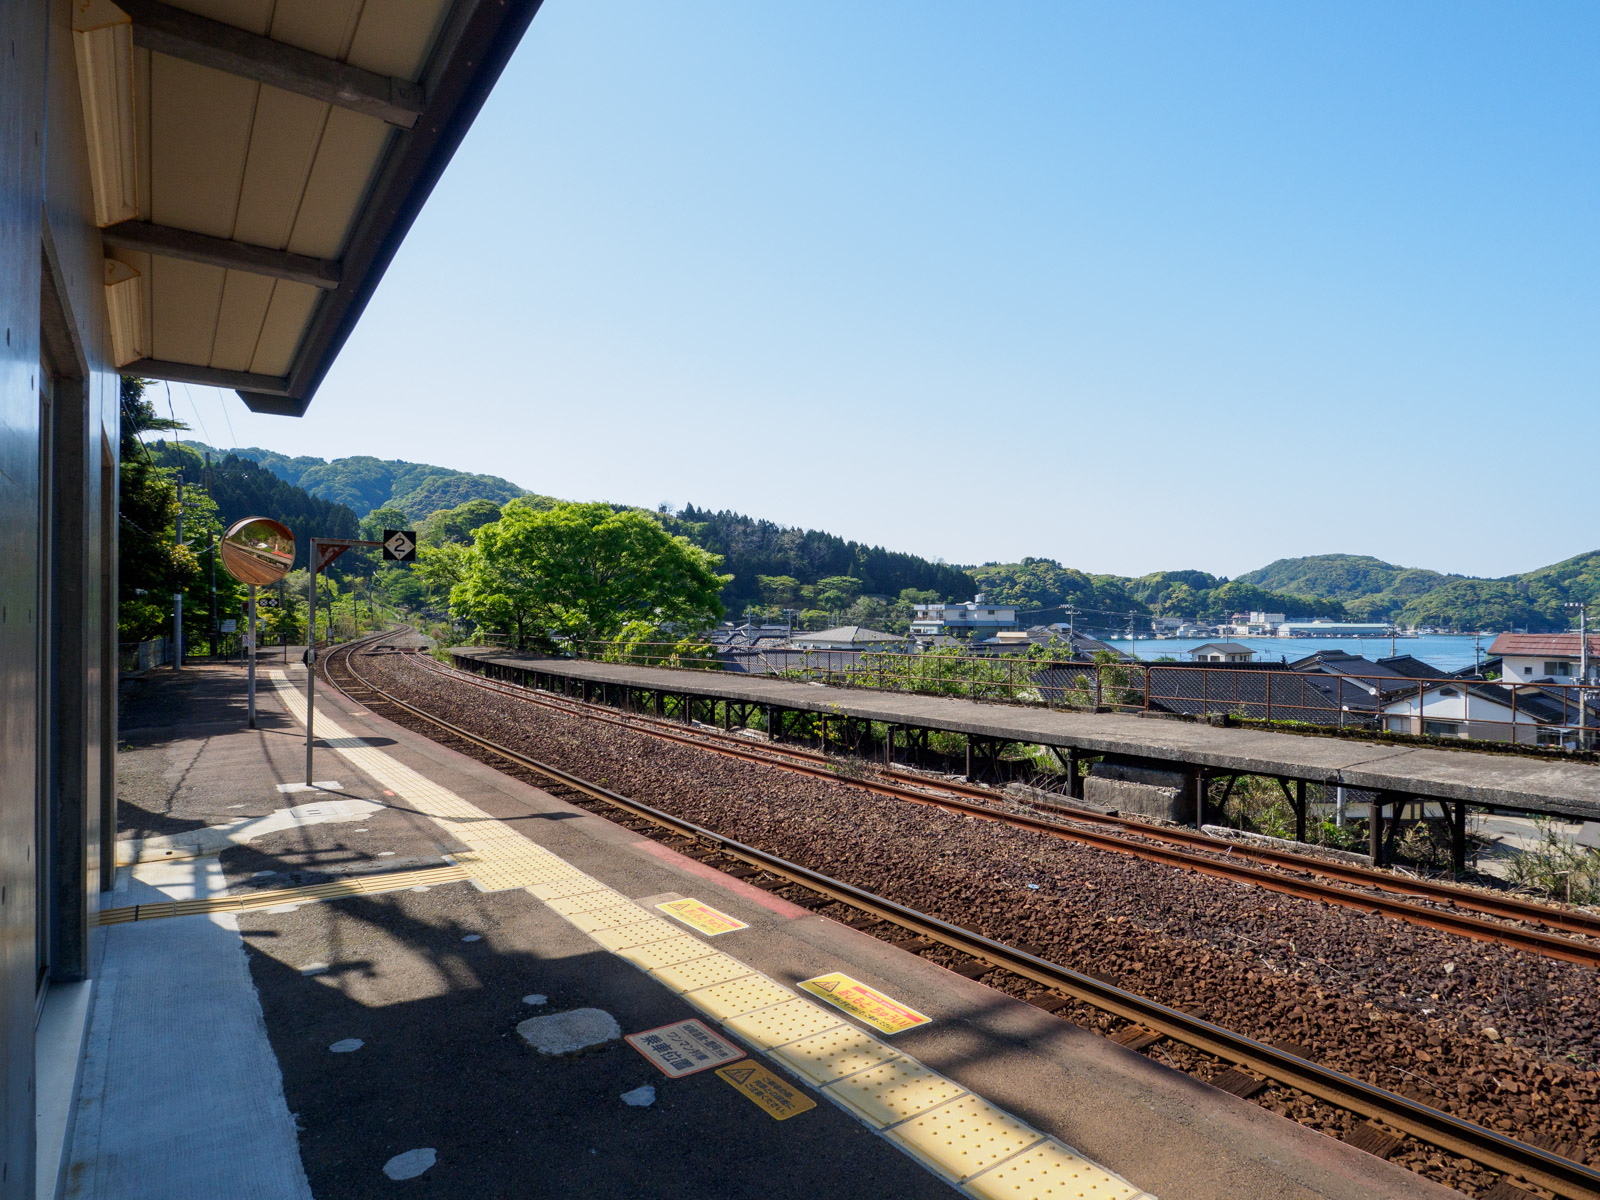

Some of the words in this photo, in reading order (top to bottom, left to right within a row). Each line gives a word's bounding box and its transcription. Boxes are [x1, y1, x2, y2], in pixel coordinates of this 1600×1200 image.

[394, 538, 405, 552] 2
[837, 989, 872, 1008] あしもと
[640, 1034, 695, 1071] 乗車位置
[666, 1032, 709, 1061] ワンマン列車
